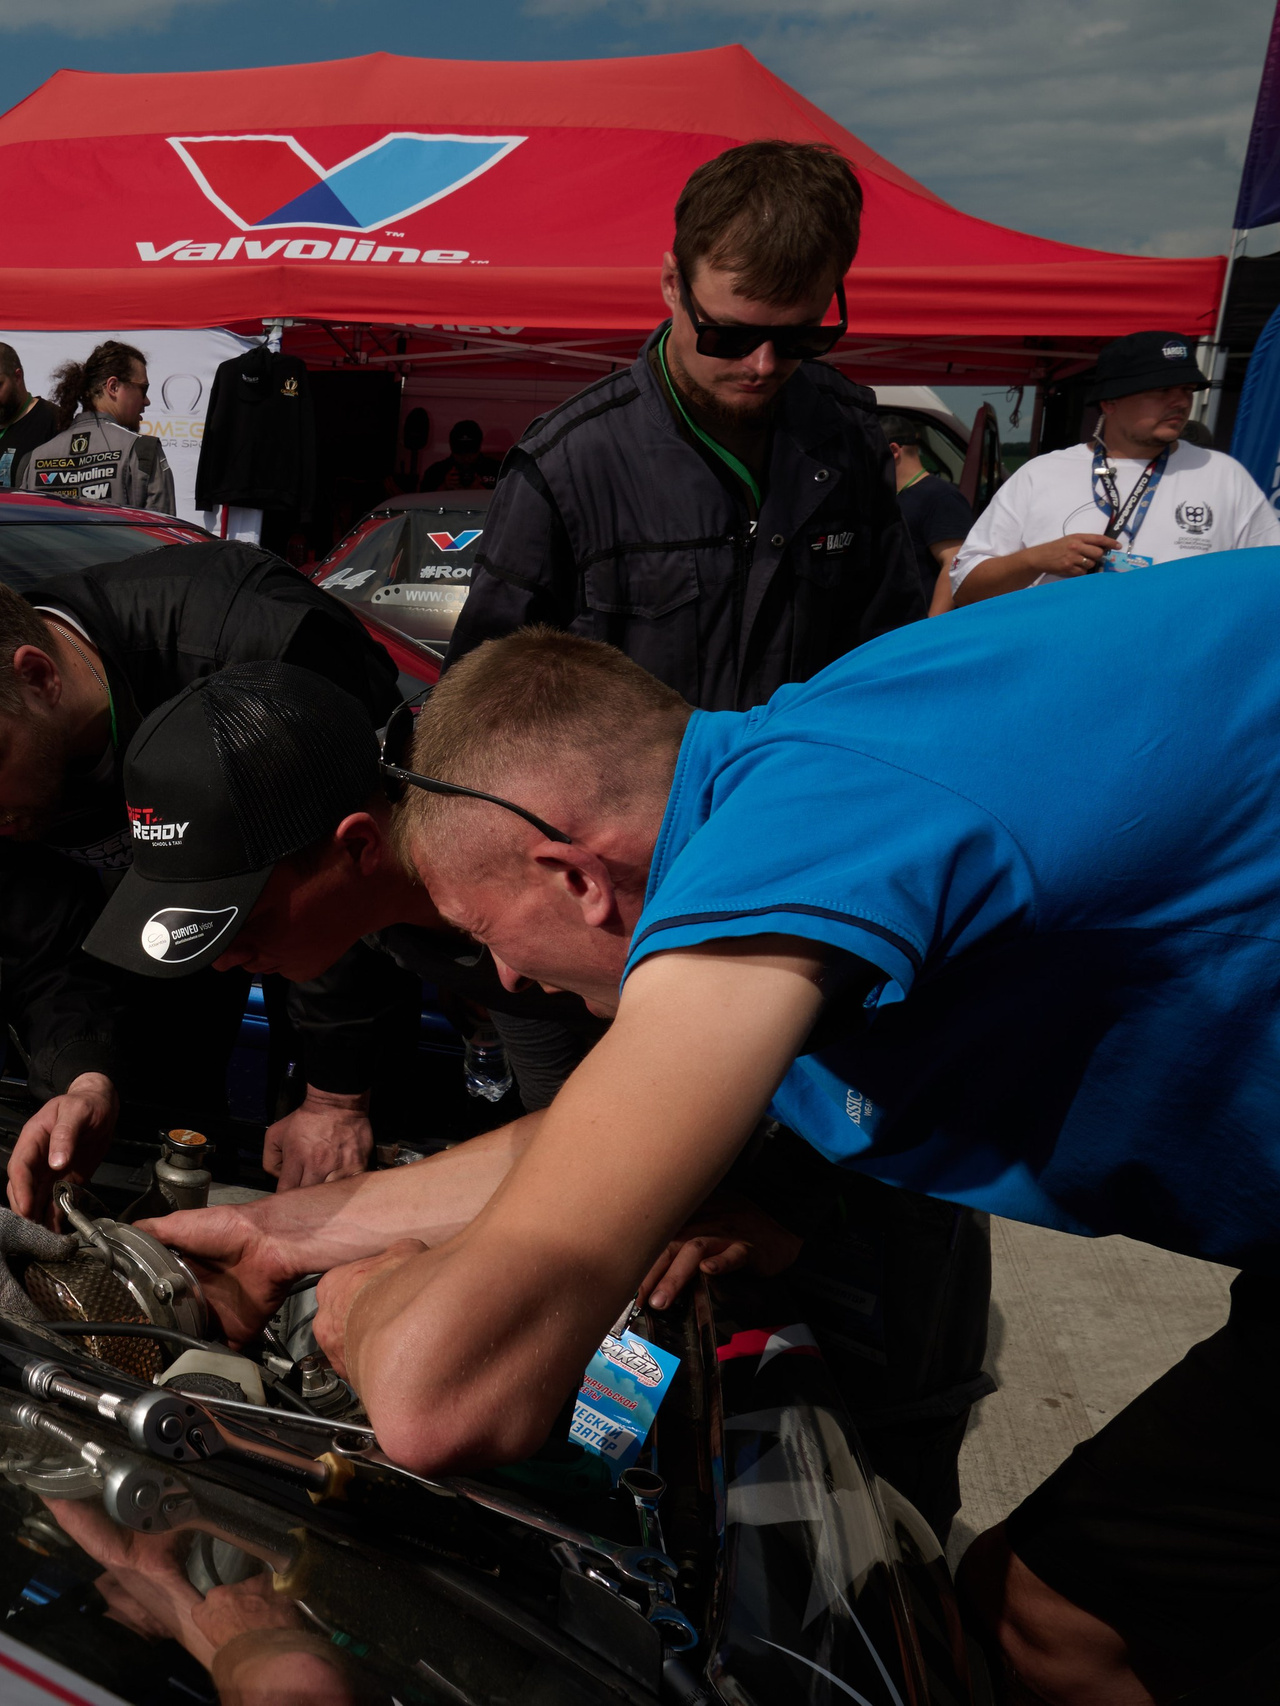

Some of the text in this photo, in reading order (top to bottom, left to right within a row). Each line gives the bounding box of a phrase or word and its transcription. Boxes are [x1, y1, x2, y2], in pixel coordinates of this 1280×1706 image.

[135, 236, 470, 264] Valvoline
[139, 421, 206, 438] OMEG
[36, 451, 121, 469] OMEGA MOTORS
[59, 466, 115, 484] Valvoline
[317, 567, 376, 590] 44
[132, 819, 190, 840] READY
[171, 921, 215, 940] CURVED visor
[600, 1338, 663, 1384] РАКЕТА
